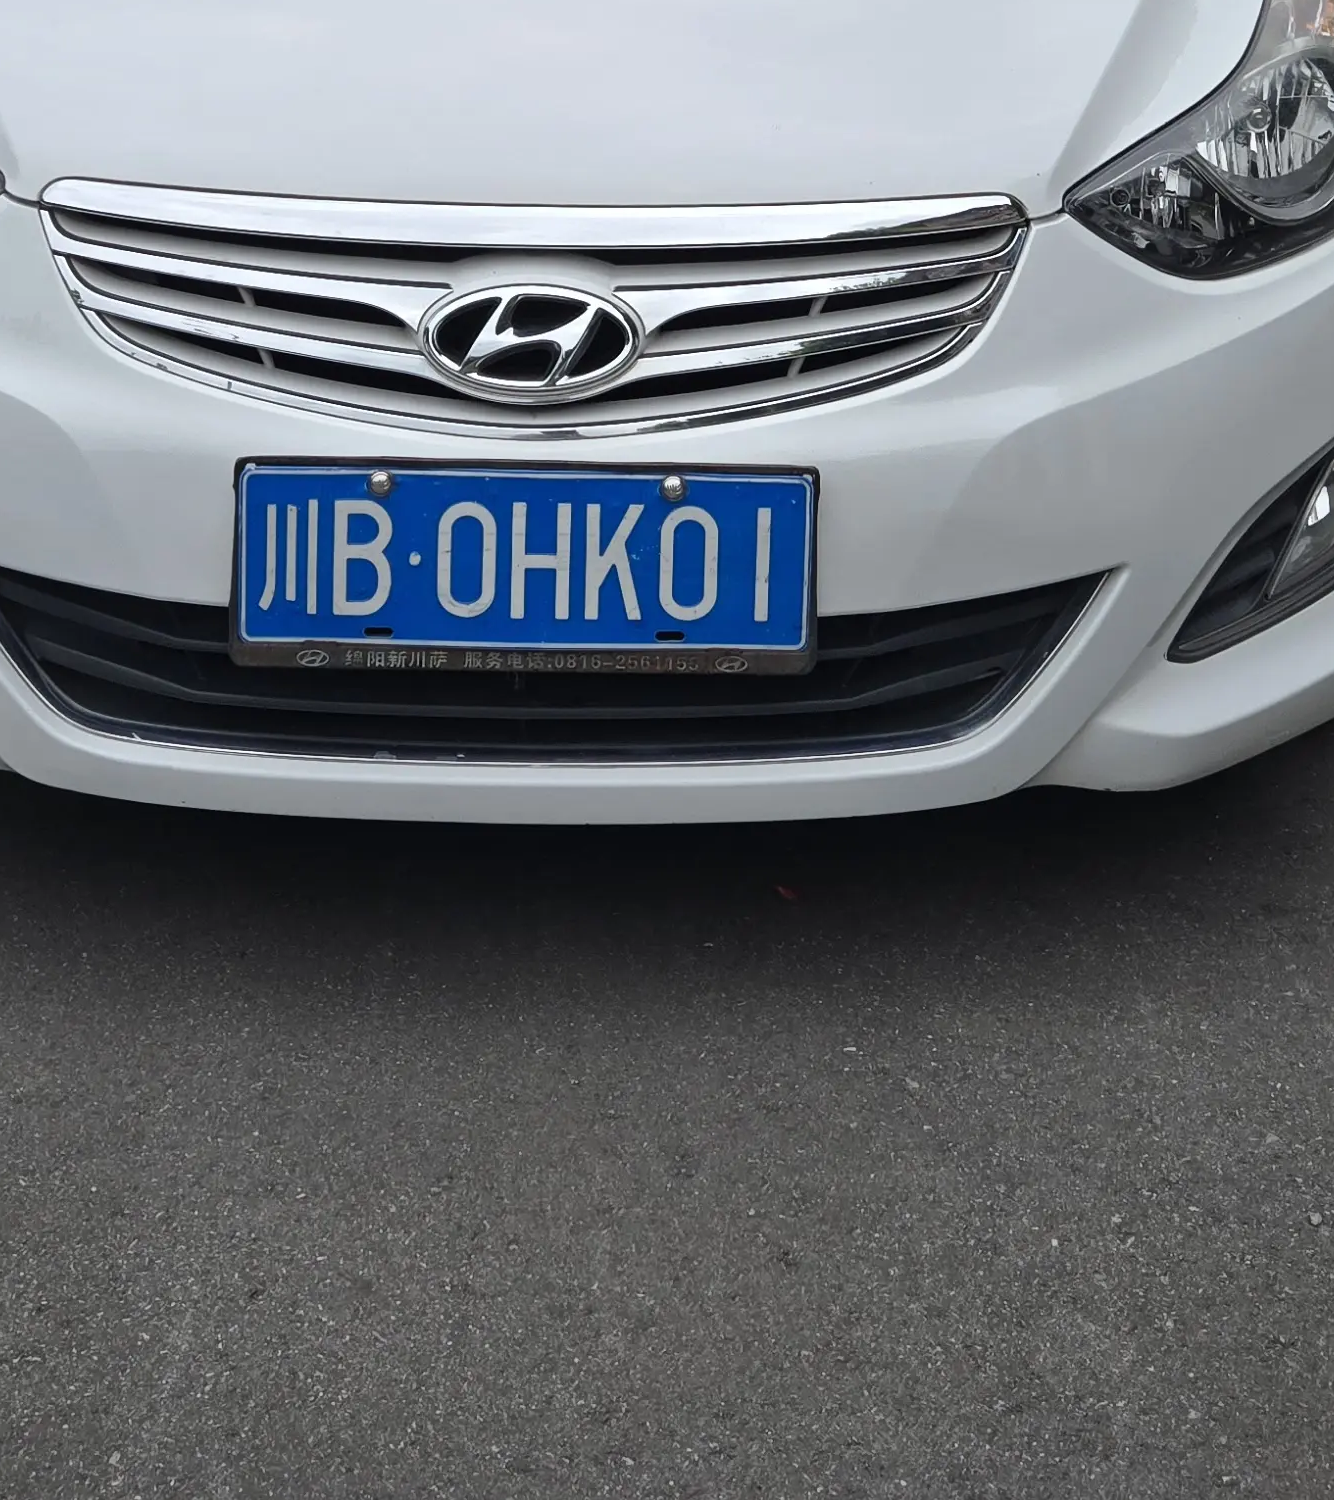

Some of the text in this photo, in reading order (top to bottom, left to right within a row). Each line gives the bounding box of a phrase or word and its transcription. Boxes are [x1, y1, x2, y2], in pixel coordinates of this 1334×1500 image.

[258, 499, 772, 622] 川B·0HK01
[344, 649, 449, 669] 绵阳新川萨
